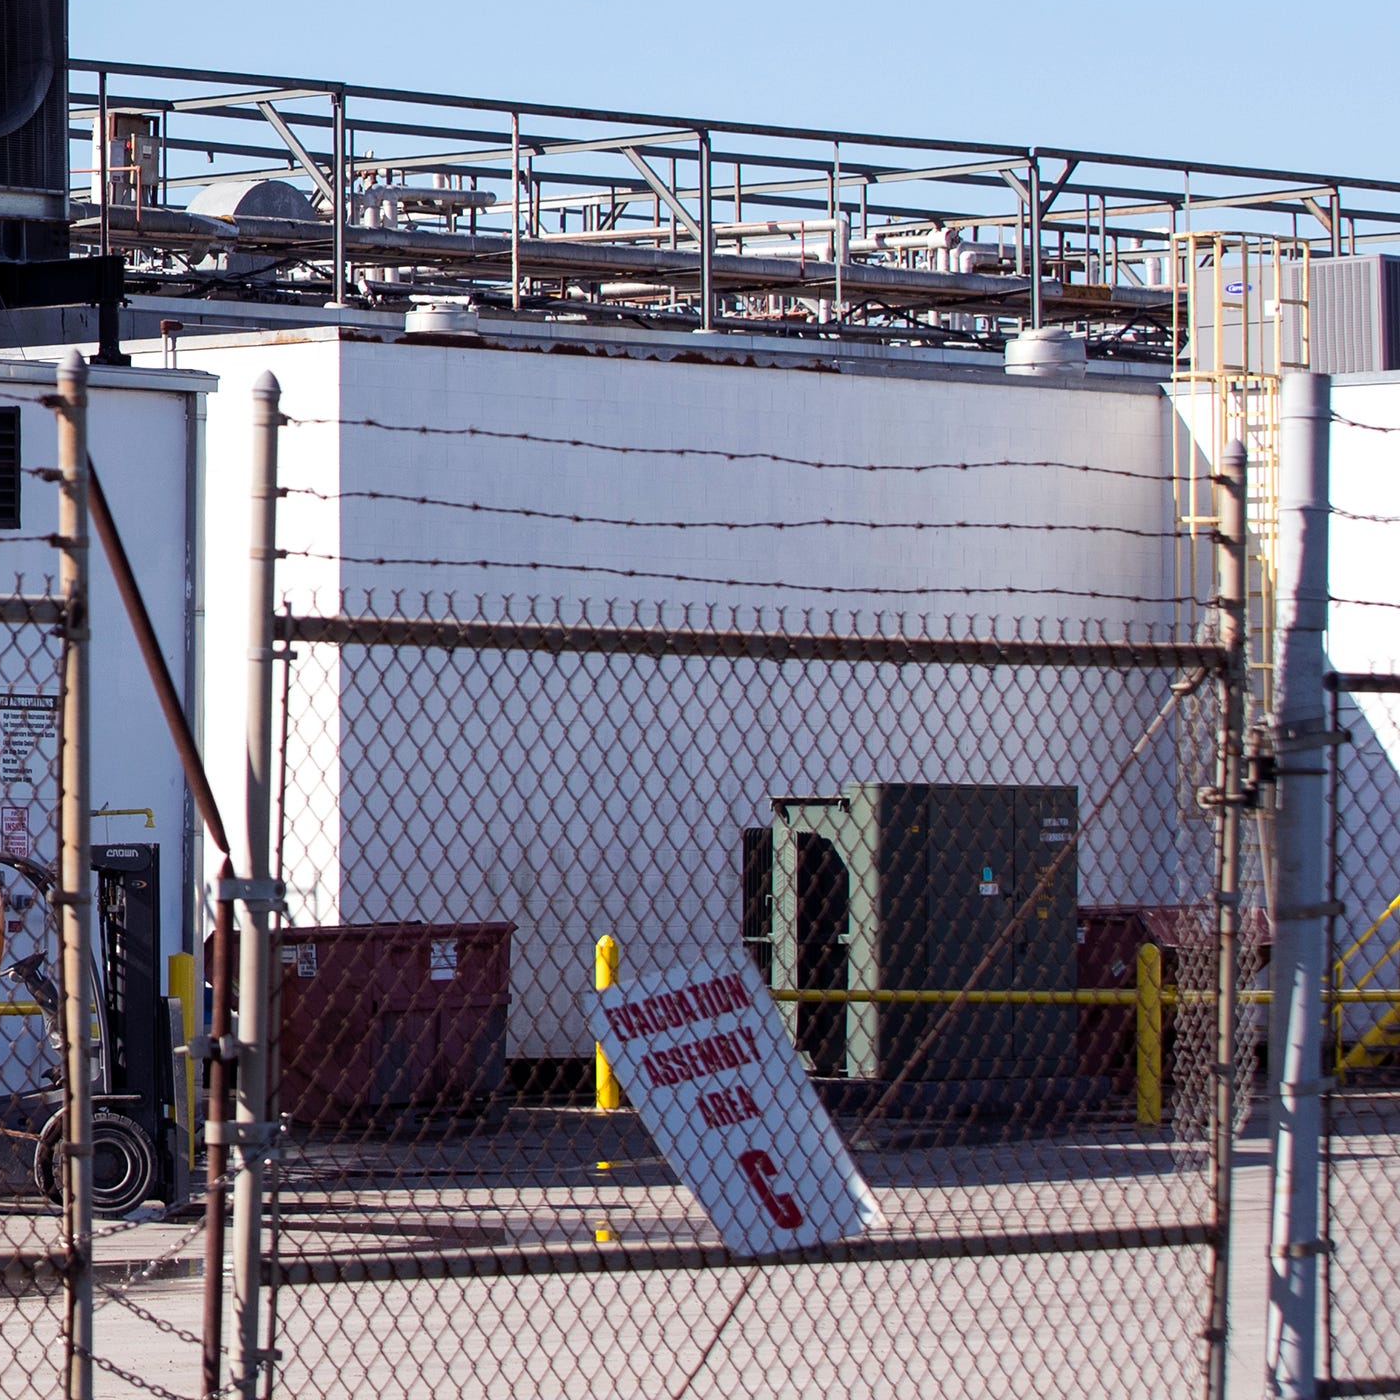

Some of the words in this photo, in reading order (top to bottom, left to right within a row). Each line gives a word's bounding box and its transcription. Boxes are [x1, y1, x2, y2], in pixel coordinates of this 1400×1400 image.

[604, 972, 750, 1043] EVACUATION
[640, 1025, 762, 1089] ASSEMBLY
[695, 1084, 762, 1130] AREA
[738, 1149, 804, 1230] C
